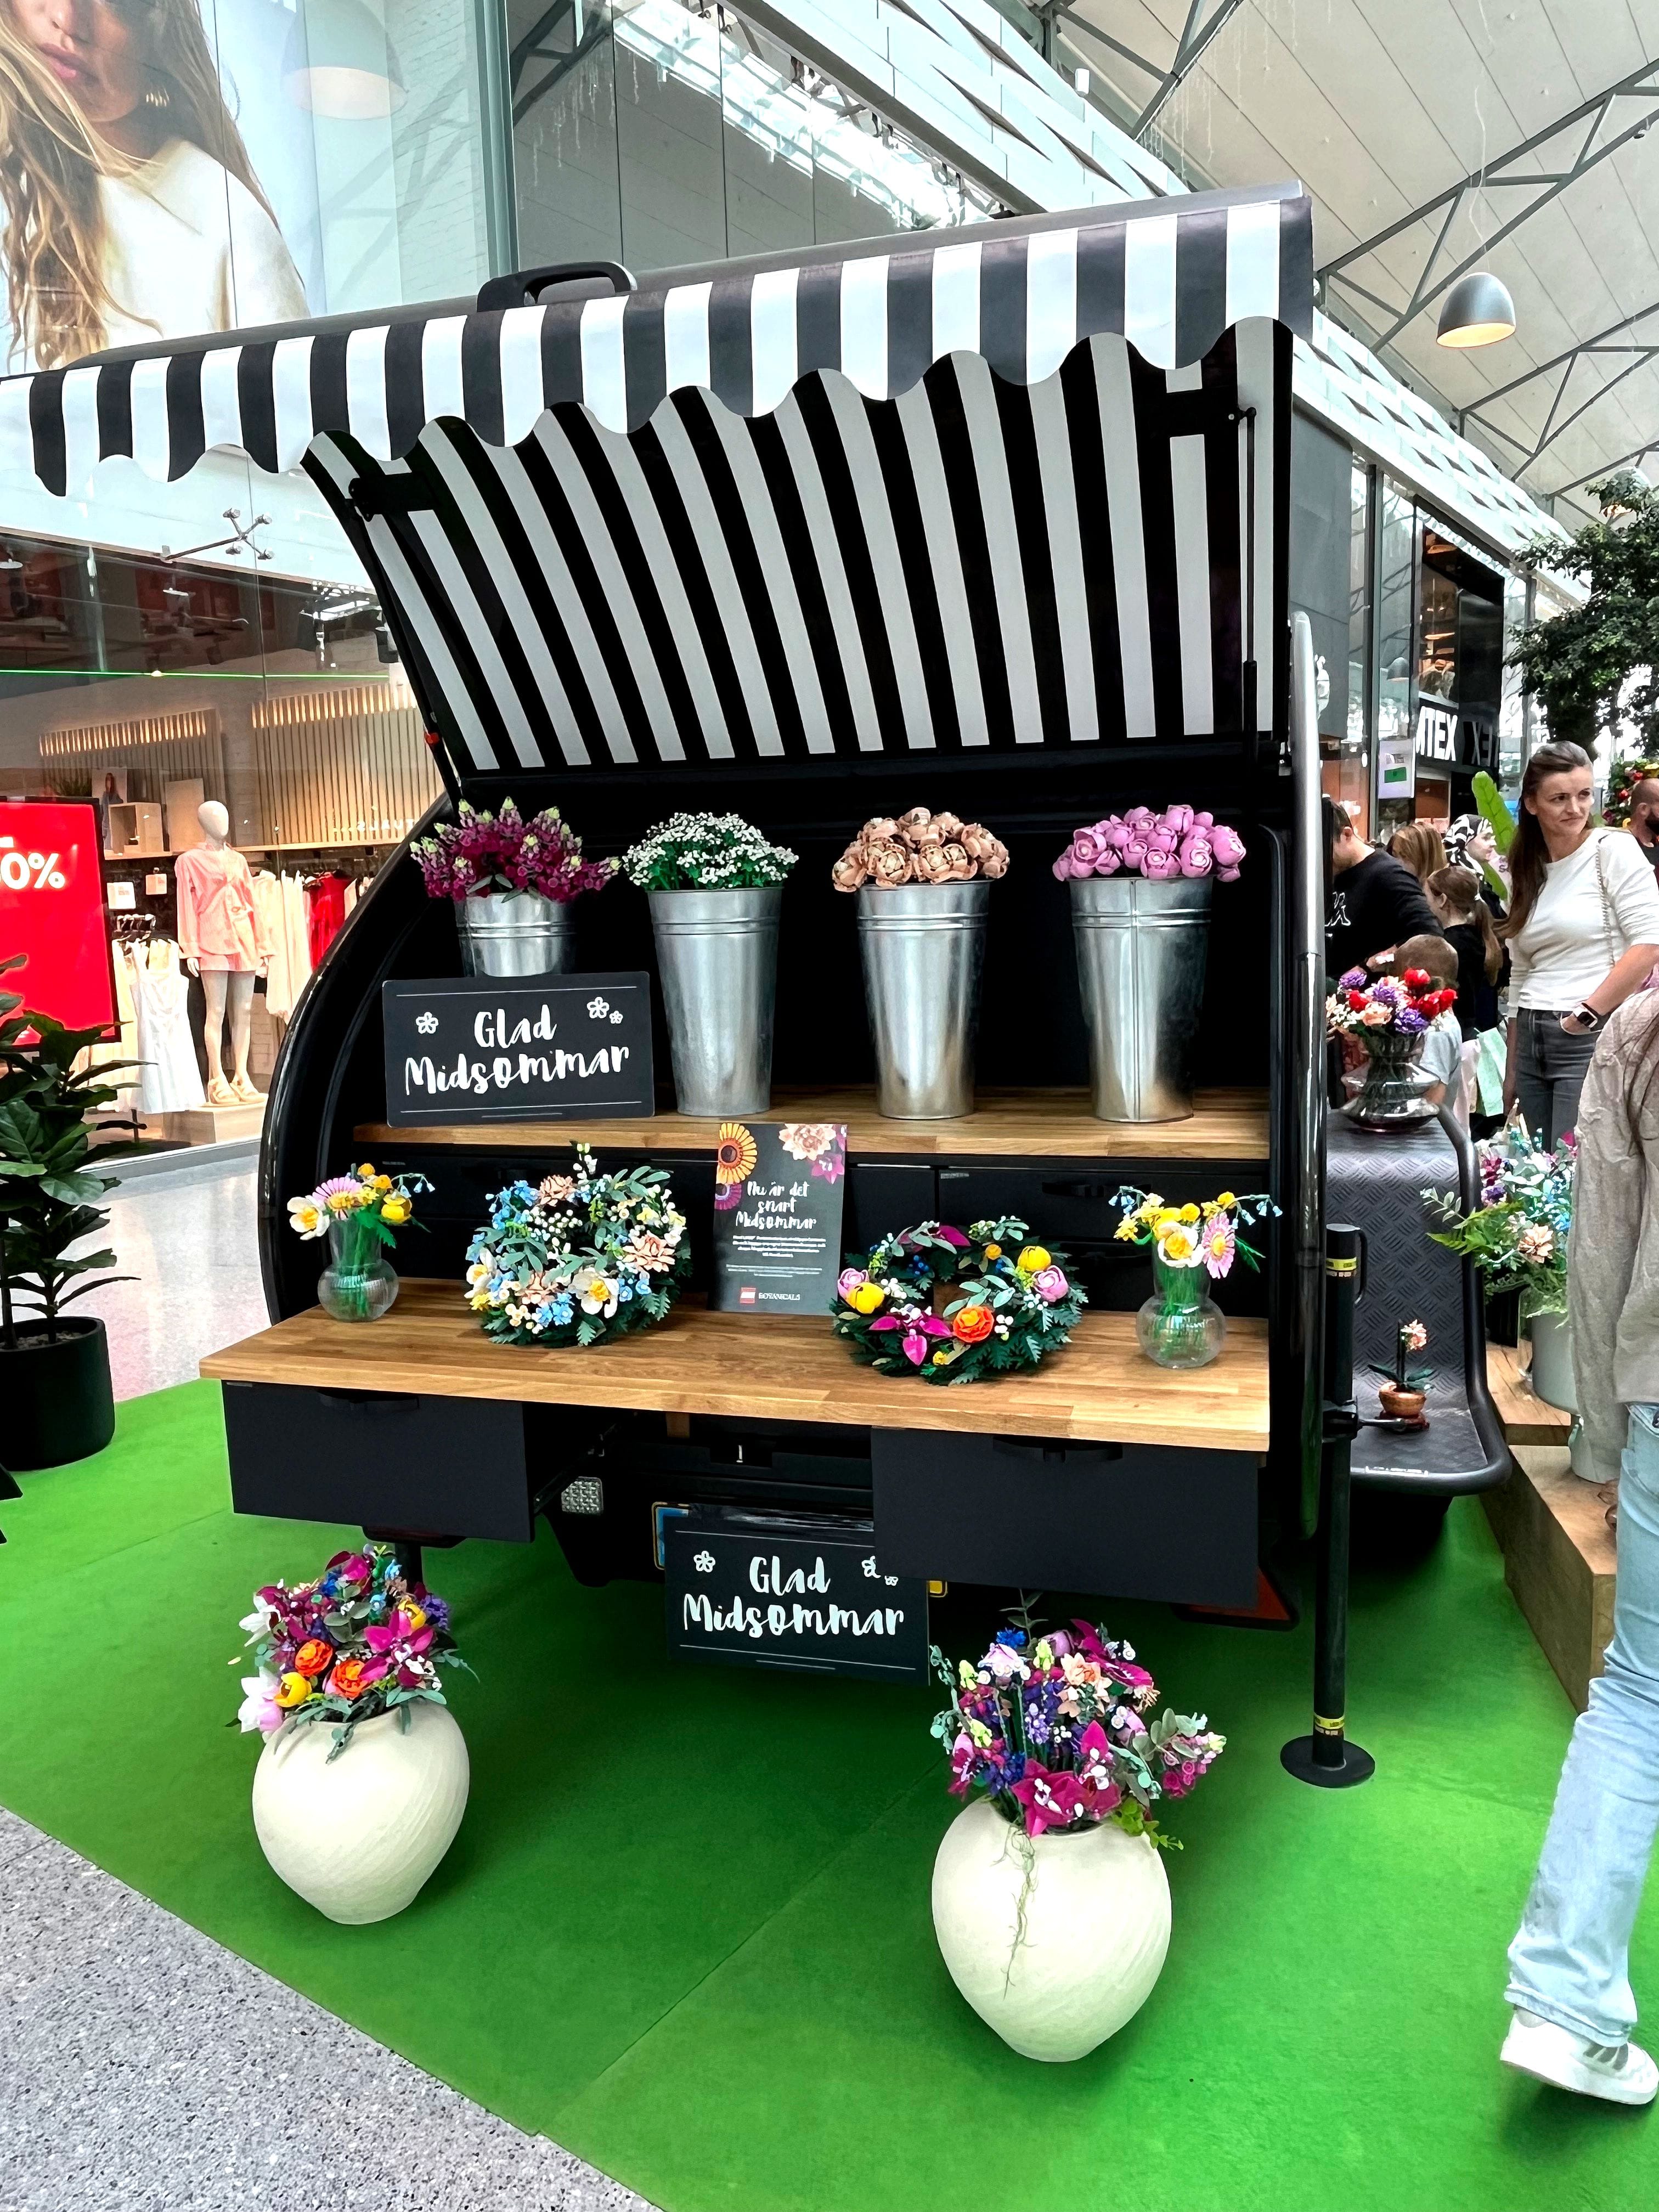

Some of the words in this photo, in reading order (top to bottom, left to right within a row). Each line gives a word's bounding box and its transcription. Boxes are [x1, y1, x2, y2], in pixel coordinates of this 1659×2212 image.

[0, 852, 65, 890] 0%
[474, 1004, 557, 1048] Glad
[405, 1046, 629, 1095] Midsommar
[747, 1181, 767, 1196] Nu
[769, 1181, 785, 1197] är
[789, 1181, 810, 1197] det
[758, 1197, 797, 1214] snart
[735, 1211, 817, 1230] Midsommar
[749, 1555, 831, 1596] Glad
[684, 1593, 904, 1638] Midsommar
